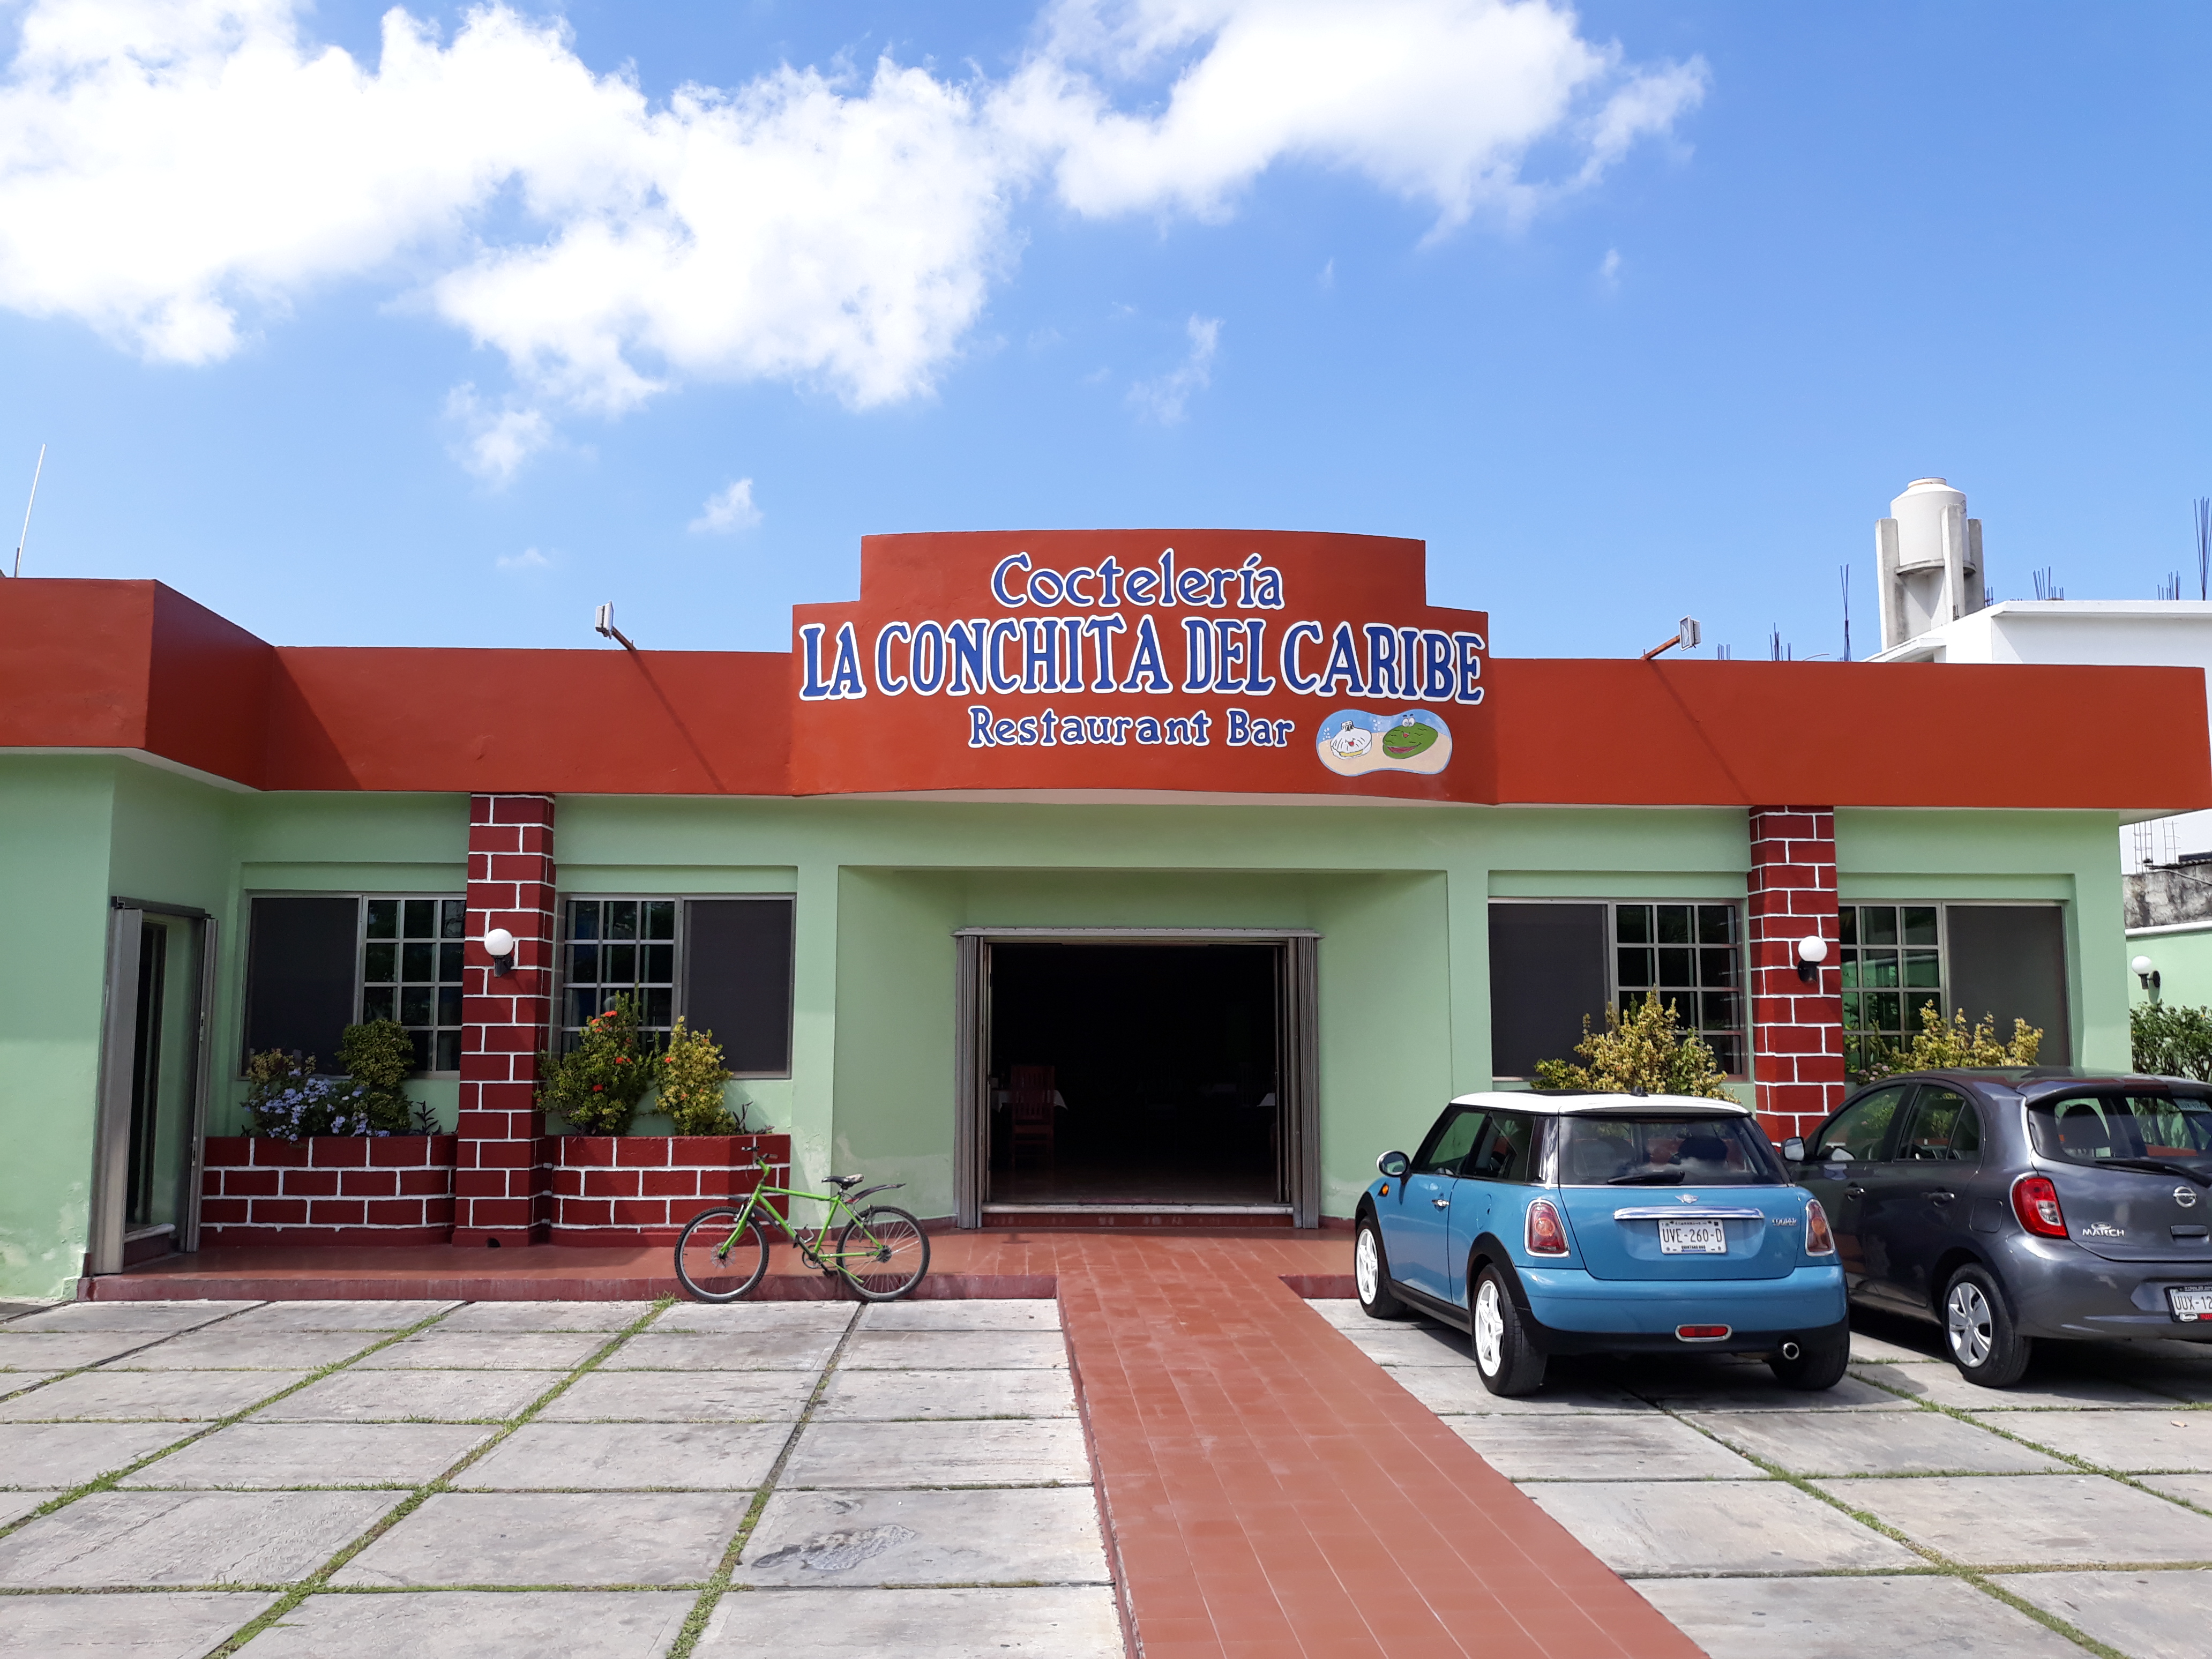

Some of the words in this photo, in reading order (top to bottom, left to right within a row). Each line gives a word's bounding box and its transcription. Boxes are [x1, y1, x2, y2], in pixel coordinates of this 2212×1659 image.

[991, 548, 1284, 610] Coctelería
[799, 622, 866, 701] LA
[875, 612, 1173, 696] CONCHITA
[1181, 617, 1276, 696] DEL
[1280, 621, 1485, 705] CARIBE
[968, 706, 1212, 748] Restaurant
[1226, 708, 1295, 748] Bar
[1662, 1228, 1722, 1243] UVE-260-D
[2082, 1228, 2125, 1237] MARCH
